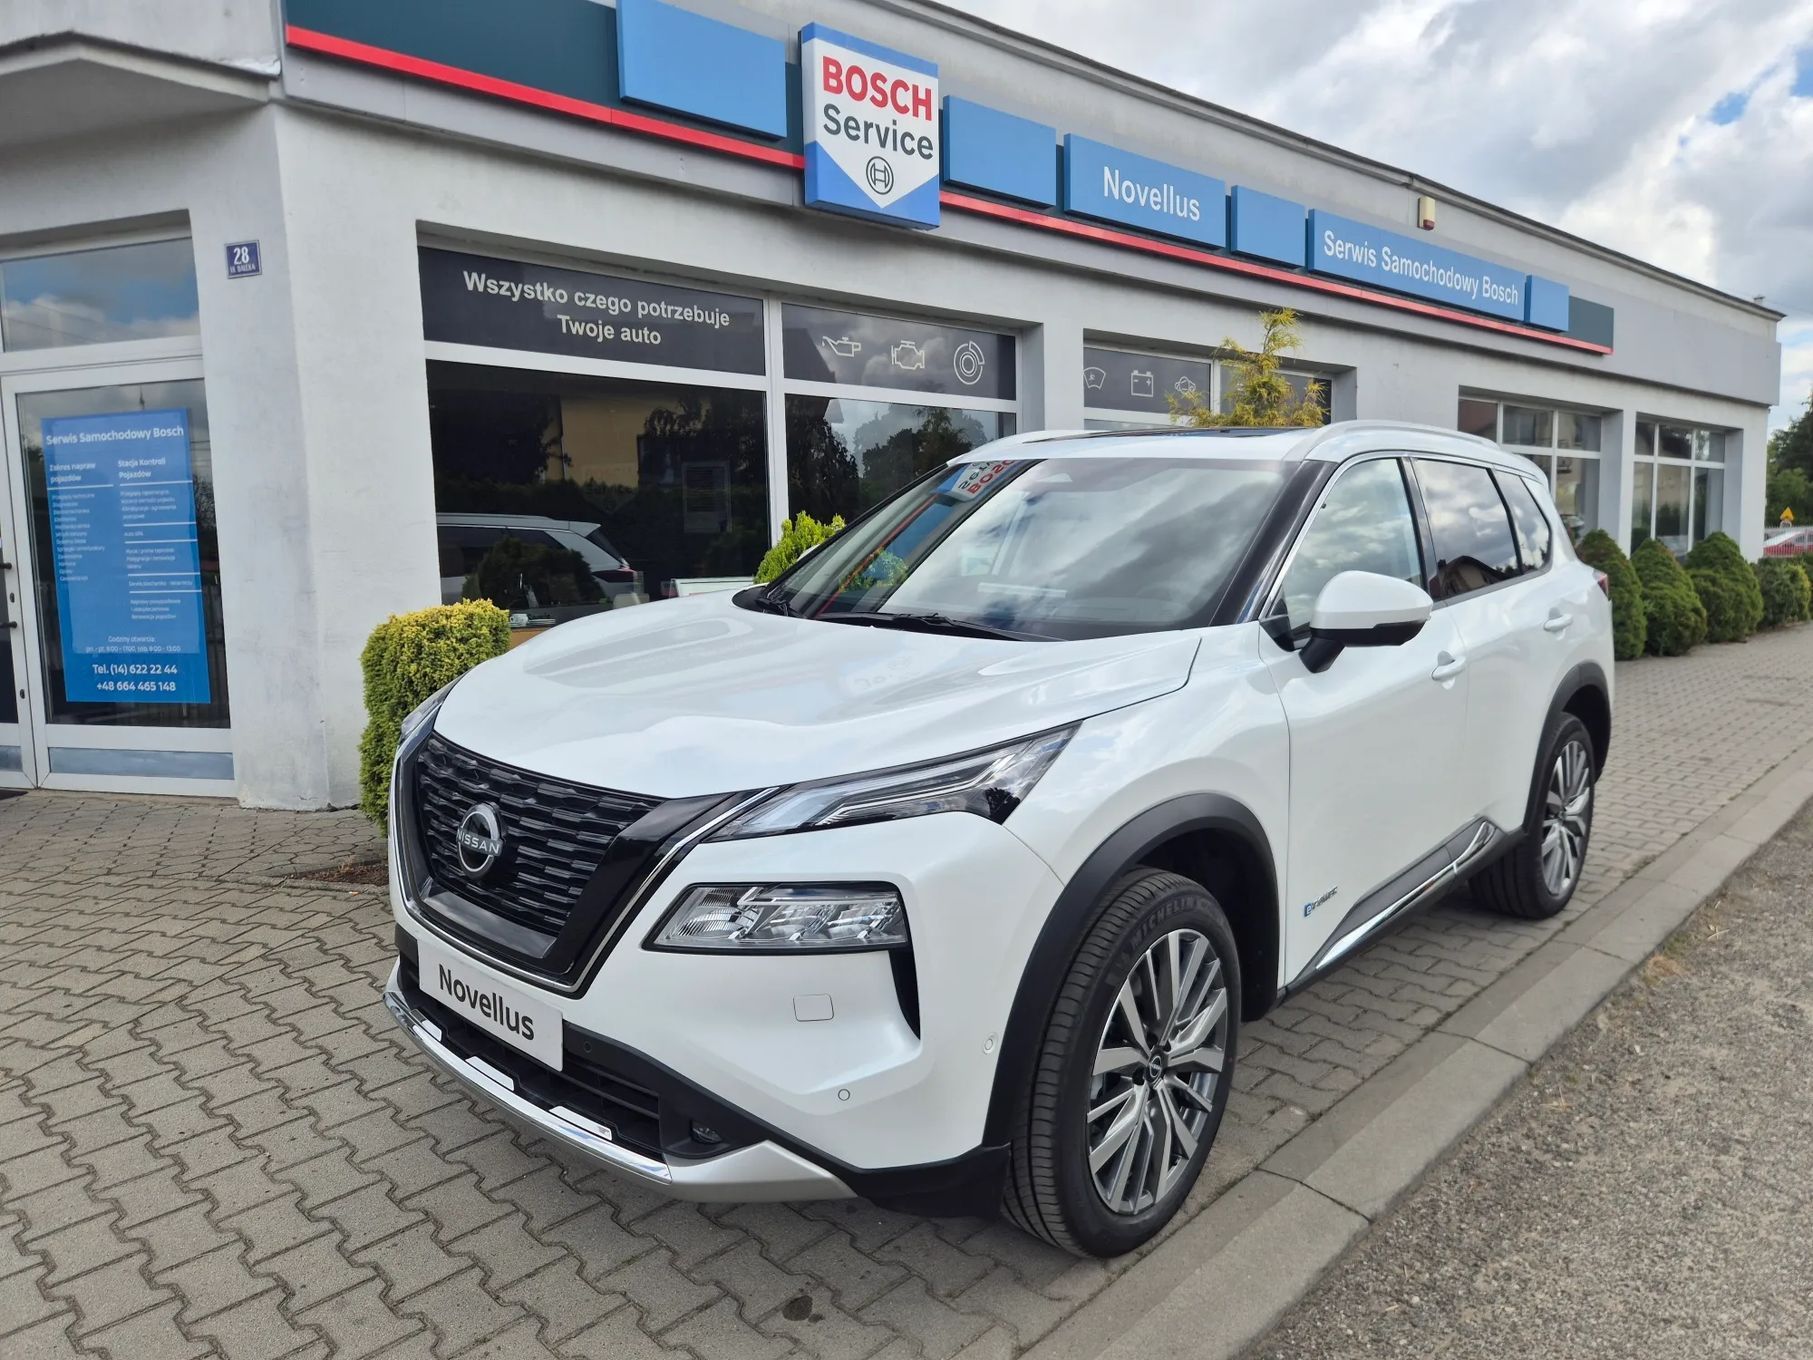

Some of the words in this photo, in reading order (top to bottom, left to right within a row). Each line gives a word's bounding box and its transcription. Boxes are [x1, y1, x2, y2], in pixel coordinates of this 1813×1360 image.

[822, 55, 932, 121] BOSCH
[823, 103, 934, 160] Service
[1103, 166, 1200, 221] Novellus
[233, 246, 249, 265] 28
[1324, 230, 1377, 267] Serwis
[1381, 246, 1479, 300] Samochodowy
[1482, 276, 1518, 305] Bosch
[463, 270, 568, 304] Wszystko
[574, 291, 632, 316] czego
[637, 300, 730, 328] potrzebuje
[557, 314, 615, 342] Twoje
[620, 327, 661, 345] auto
[46, 433, 78, 445] Serwis
[79, 429, 152, 443] Samochodowy
[153, 425, 184, 438] Bosch
[71, 462, 96, 471] napraw
[118, 459, 138, 468] Stacja
[139, 457, 166, 466] Kontroli
[92, 664, 109, 674] Tel.
[110, 664, 128, 676] (14)
[129, 664, 148, 674] 622
[149, 664, 162, 674] 22
[164, 664, 178, 674] 44
[97, 681, 115, 691] +48
[116, 681, 136, 691] 664
[137, 681, 157, 691] 465
[158, 681, 176, 691] 148
[457, 828, 500, 854] NISSAN
[438, 963, 535, 1041] Novellus
